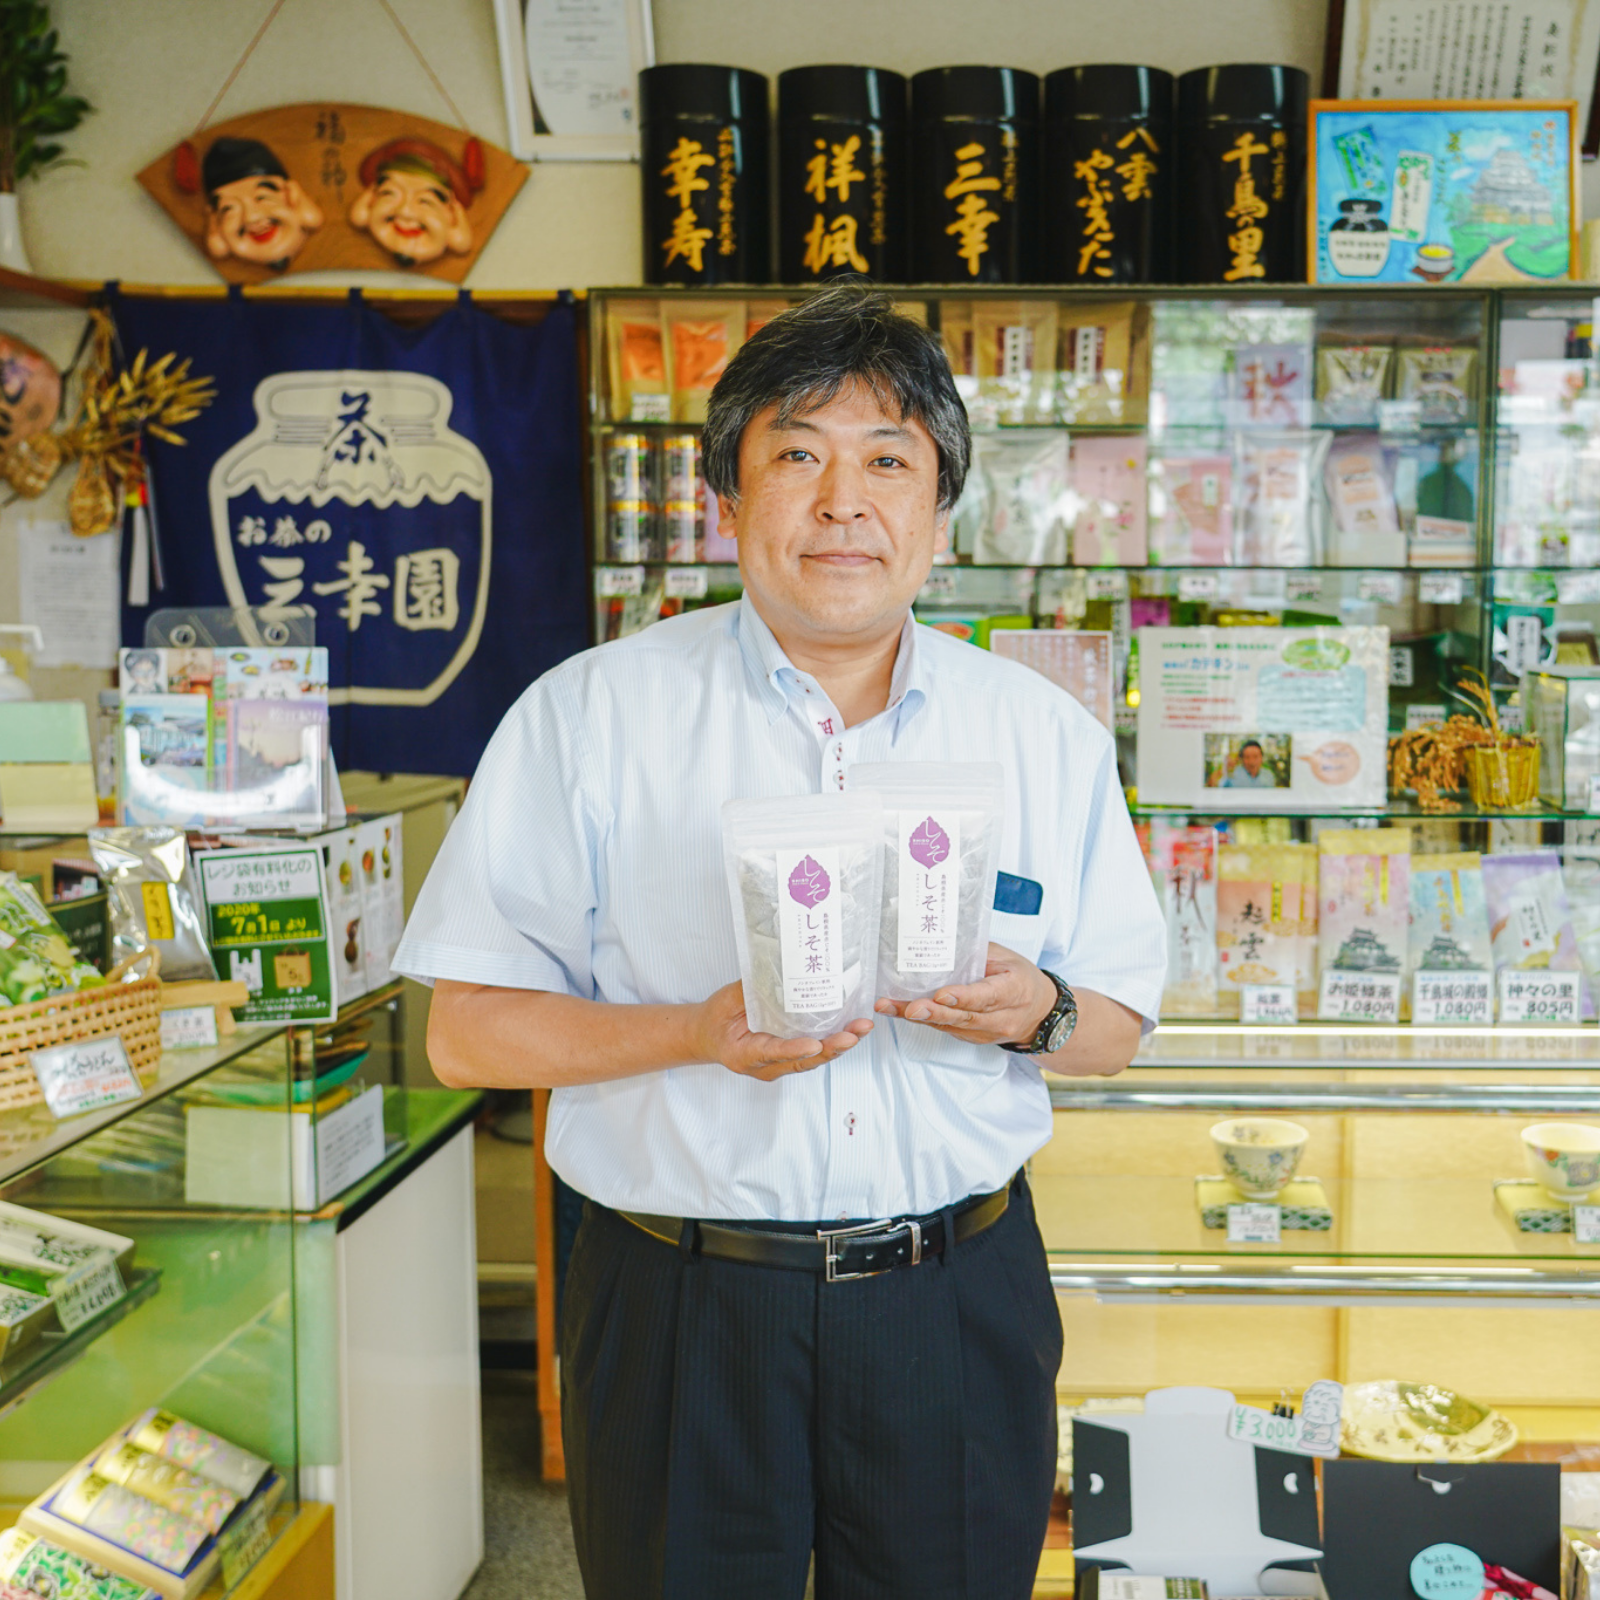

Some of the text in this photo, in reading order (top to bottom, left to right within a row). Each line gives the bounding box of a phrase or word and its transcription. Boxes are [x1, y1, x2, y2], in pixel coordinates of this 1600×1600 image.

[1115, 127, 1160, 201] 八雲
[660, 136, 716, 272] 幸寿
[944, 142, 1002, 276] 三幸
[1074, 149, 1115, 278] やぶきた
[1221, 132, 1269, 281] 千鳥の里
[321, 391, 389, 464] 茶
[237, 515, 332, 547] お茶の
[257, 540, 460, 632] 三幸園
[207, 859, 312, 880] レジ袋有料化の
[233, 880, 291, 897] お知らせ
[217, 902, 260, 918] 2020年
[920, 873, 938, 934] しそ茶
[804, 913, 823, 973] しそ茶
[1508, 984, 1573, 998] 神々の里
[1527, 1001, 1573, 1014] 805円
